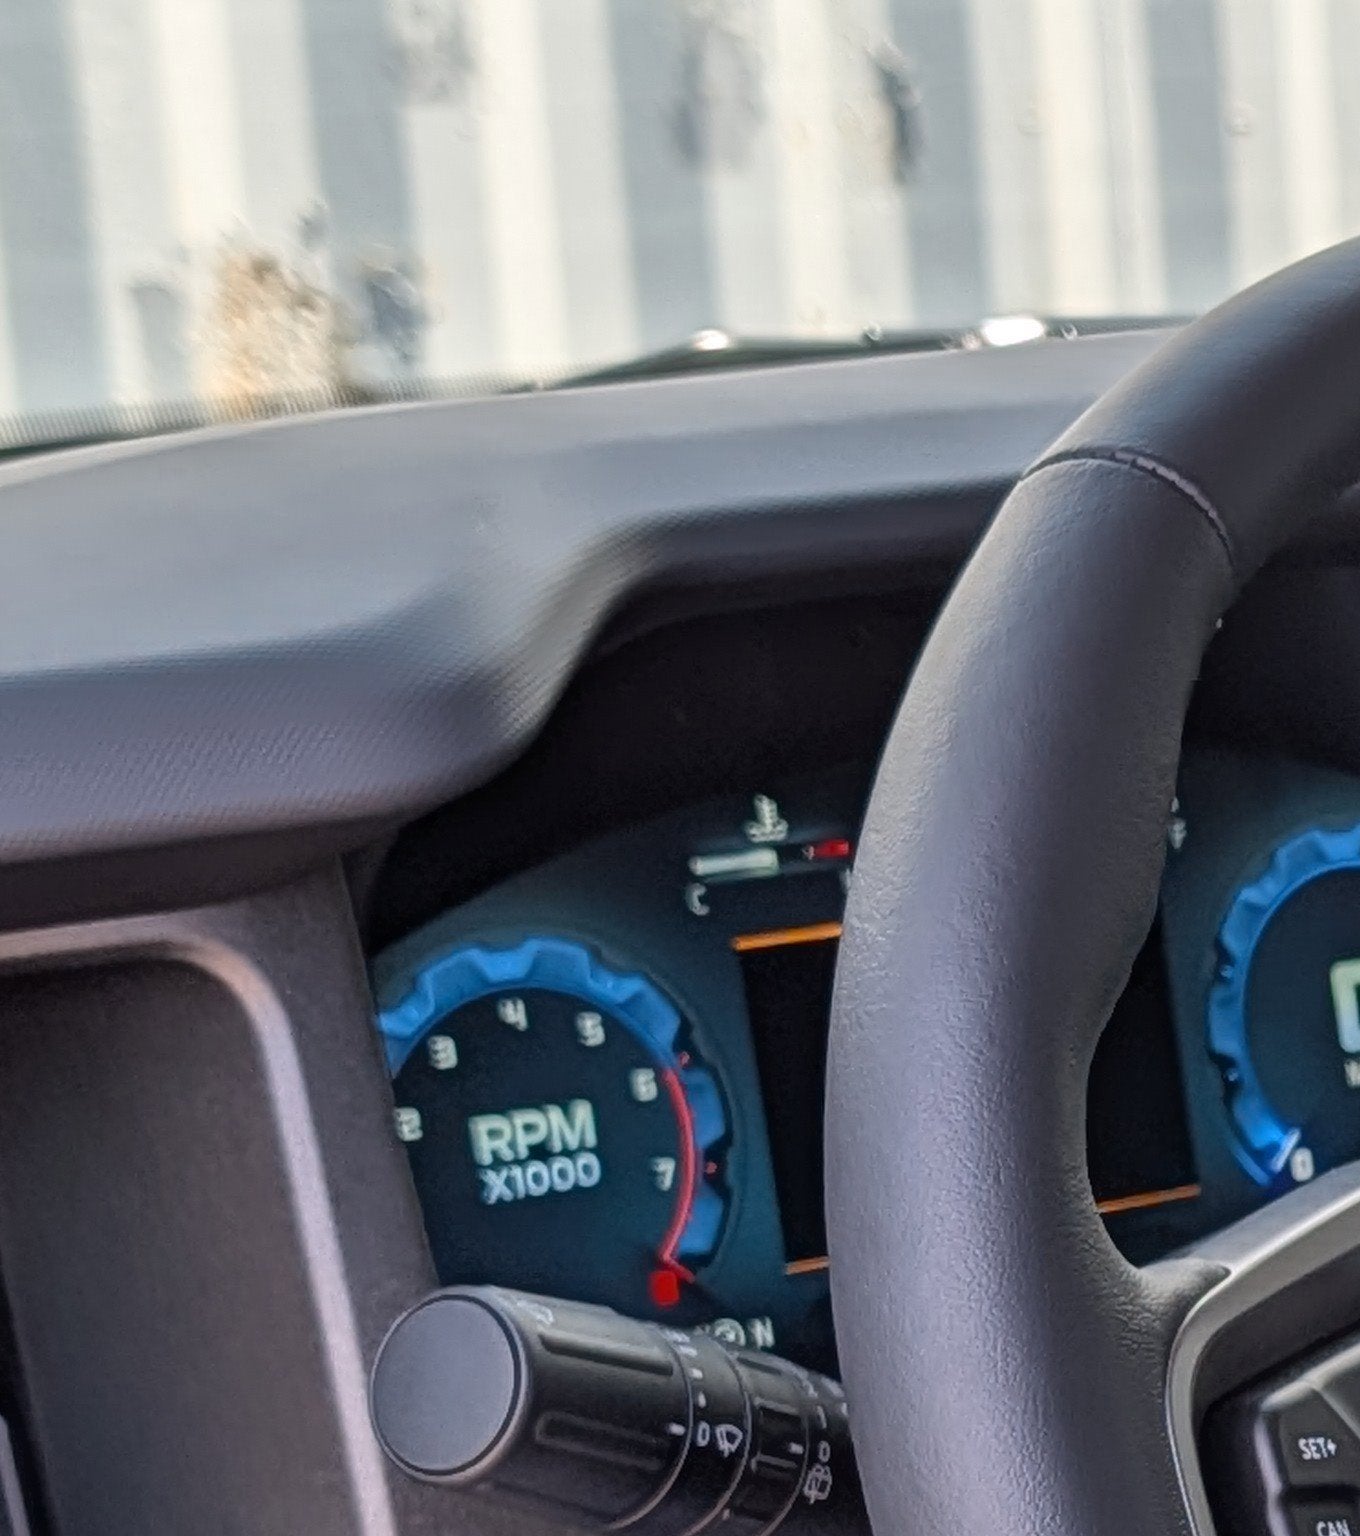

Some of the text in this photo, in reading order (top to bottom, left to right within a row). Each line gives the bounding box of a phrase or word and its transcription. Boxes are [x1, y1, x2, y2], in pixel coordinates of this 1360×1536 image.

[499, 997, 528, 1031] 4
[427, 1035, 458, 1069] 3
[468, 1099, 597, 1165] RPM
